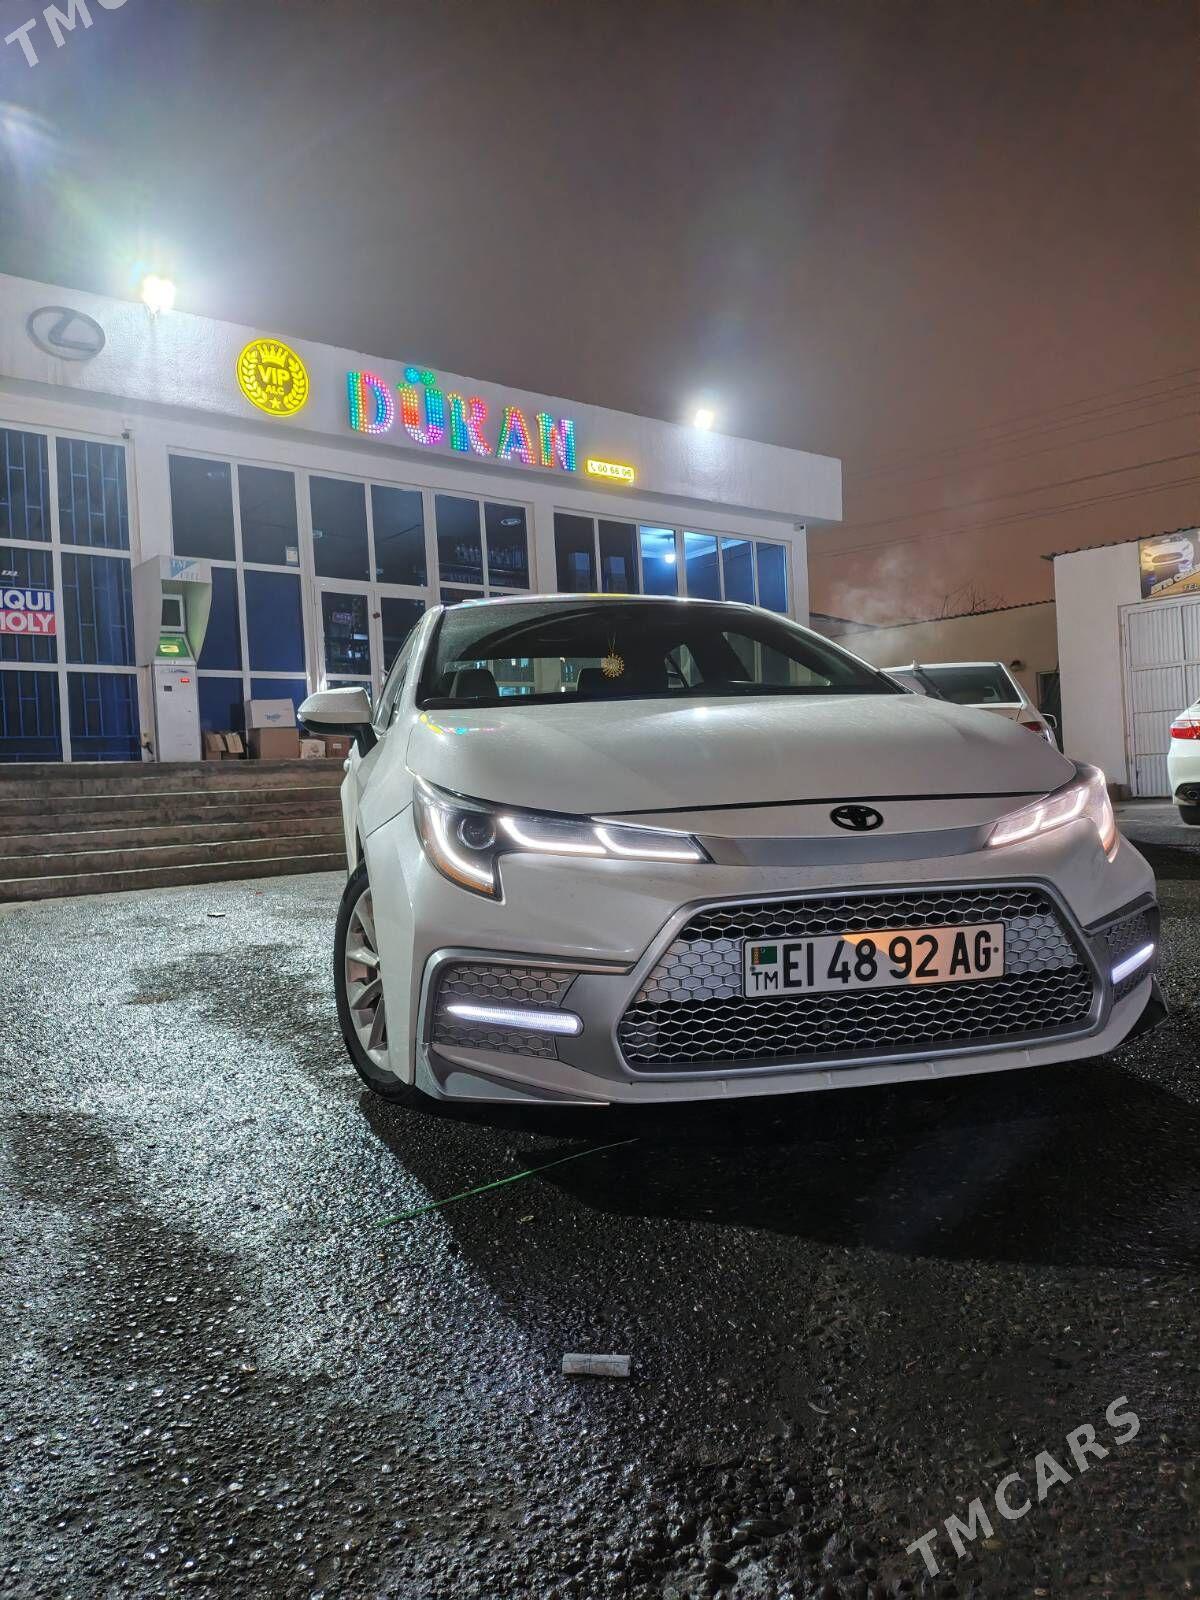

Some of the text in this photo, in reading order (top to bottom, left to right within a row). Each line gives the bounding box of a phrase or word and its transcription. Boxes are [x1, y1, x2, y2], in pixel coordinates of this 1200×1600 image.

[258, 365, 290, 386] VIP
[346, 367, 577, 471] DÜKAN
[783, 930, 991, 988] EI 48 92 AG
[751, 971, 779, 991] TM
